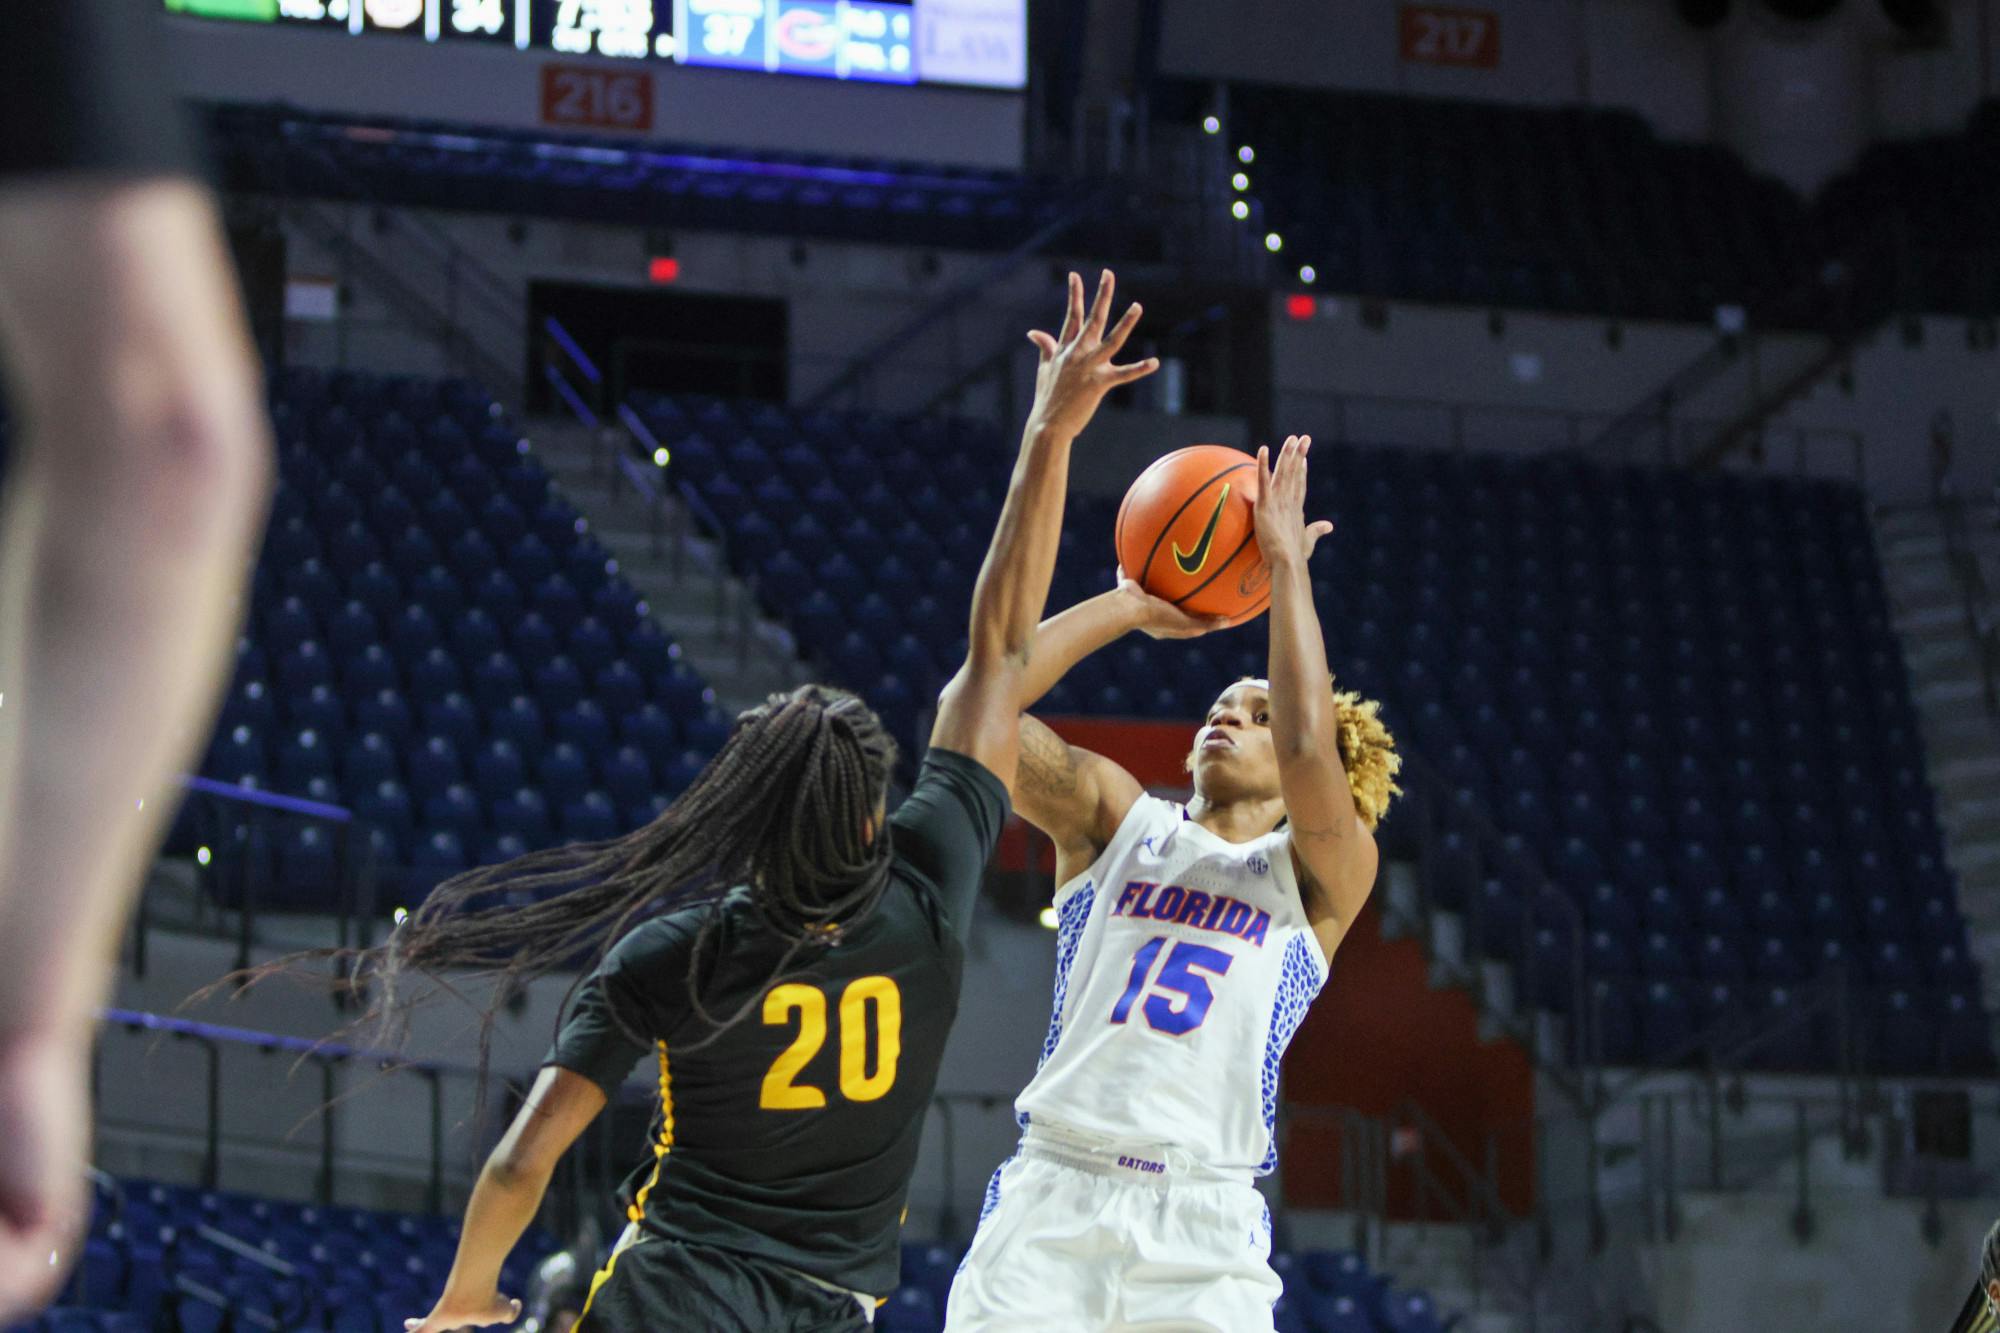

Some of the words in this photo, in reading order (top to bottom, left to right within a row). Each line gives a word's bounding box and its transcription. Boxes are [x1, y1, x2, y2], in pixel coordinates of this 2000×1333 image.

[1412, 12, 1485, 56] 217
[552, 71, 642, 122] 216
[1112, 880, 1272, 948] FLORIDA
[1109, 936, 1235, 1037] 15
[759, 975, 902, 1110] 20
[1117, 1155, 1166, 1174] GATORS
